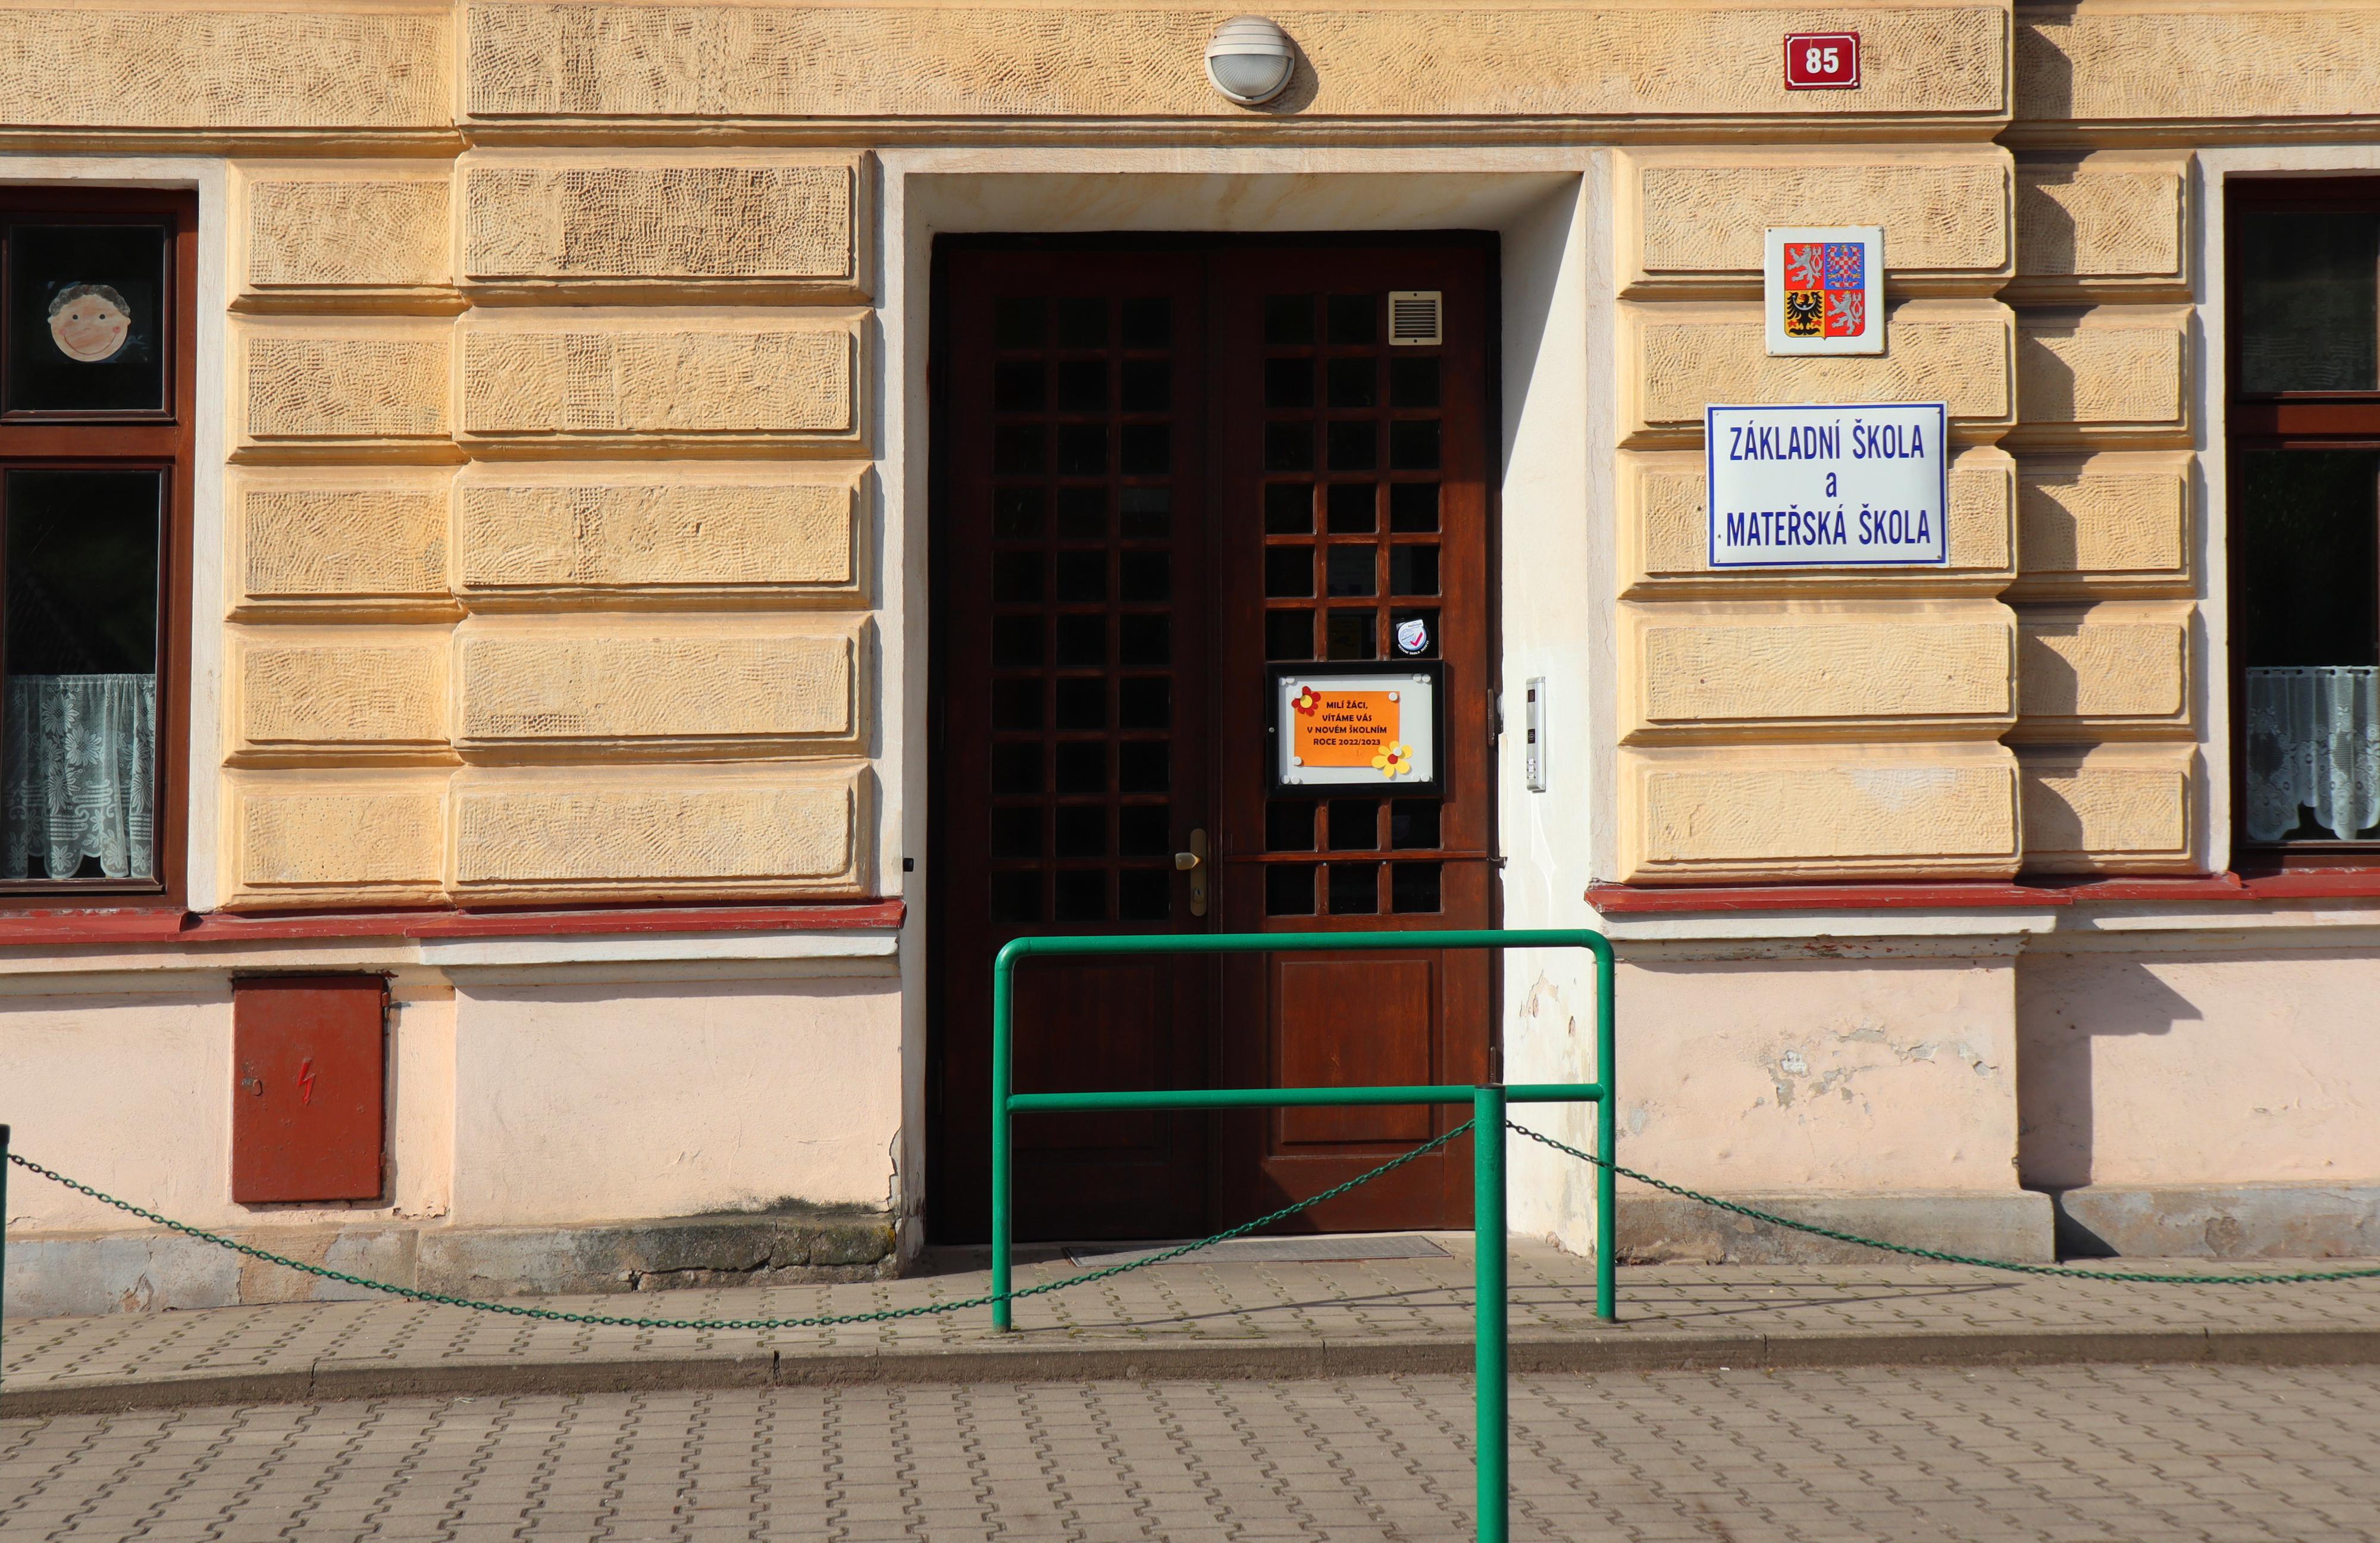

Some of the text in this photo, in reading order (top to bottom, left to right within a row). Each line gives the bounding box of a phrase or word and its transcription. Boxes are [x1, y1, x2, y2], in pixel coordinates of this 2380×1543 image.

[1806, 48, 1839, 74] 85
[1730, 418, 1924, 461] ZÁKLADNÍ ŠKOLA
[1825, 472, 1837, 498] a
[1727, 503, 1931, 547] MATEŘSKÁ ŠKOLA
[1326, 699, 1368, 710] MILÍ ŽÁCI,
[1321, 713, 1372, 722] VÍTÁME VÁS
[1315, 724, 1347, 734] NOVÉM
[1349, 724, 1387, 734] ŠKOLNÍM
[1338, 738, 1381, 746] 2022/2023
